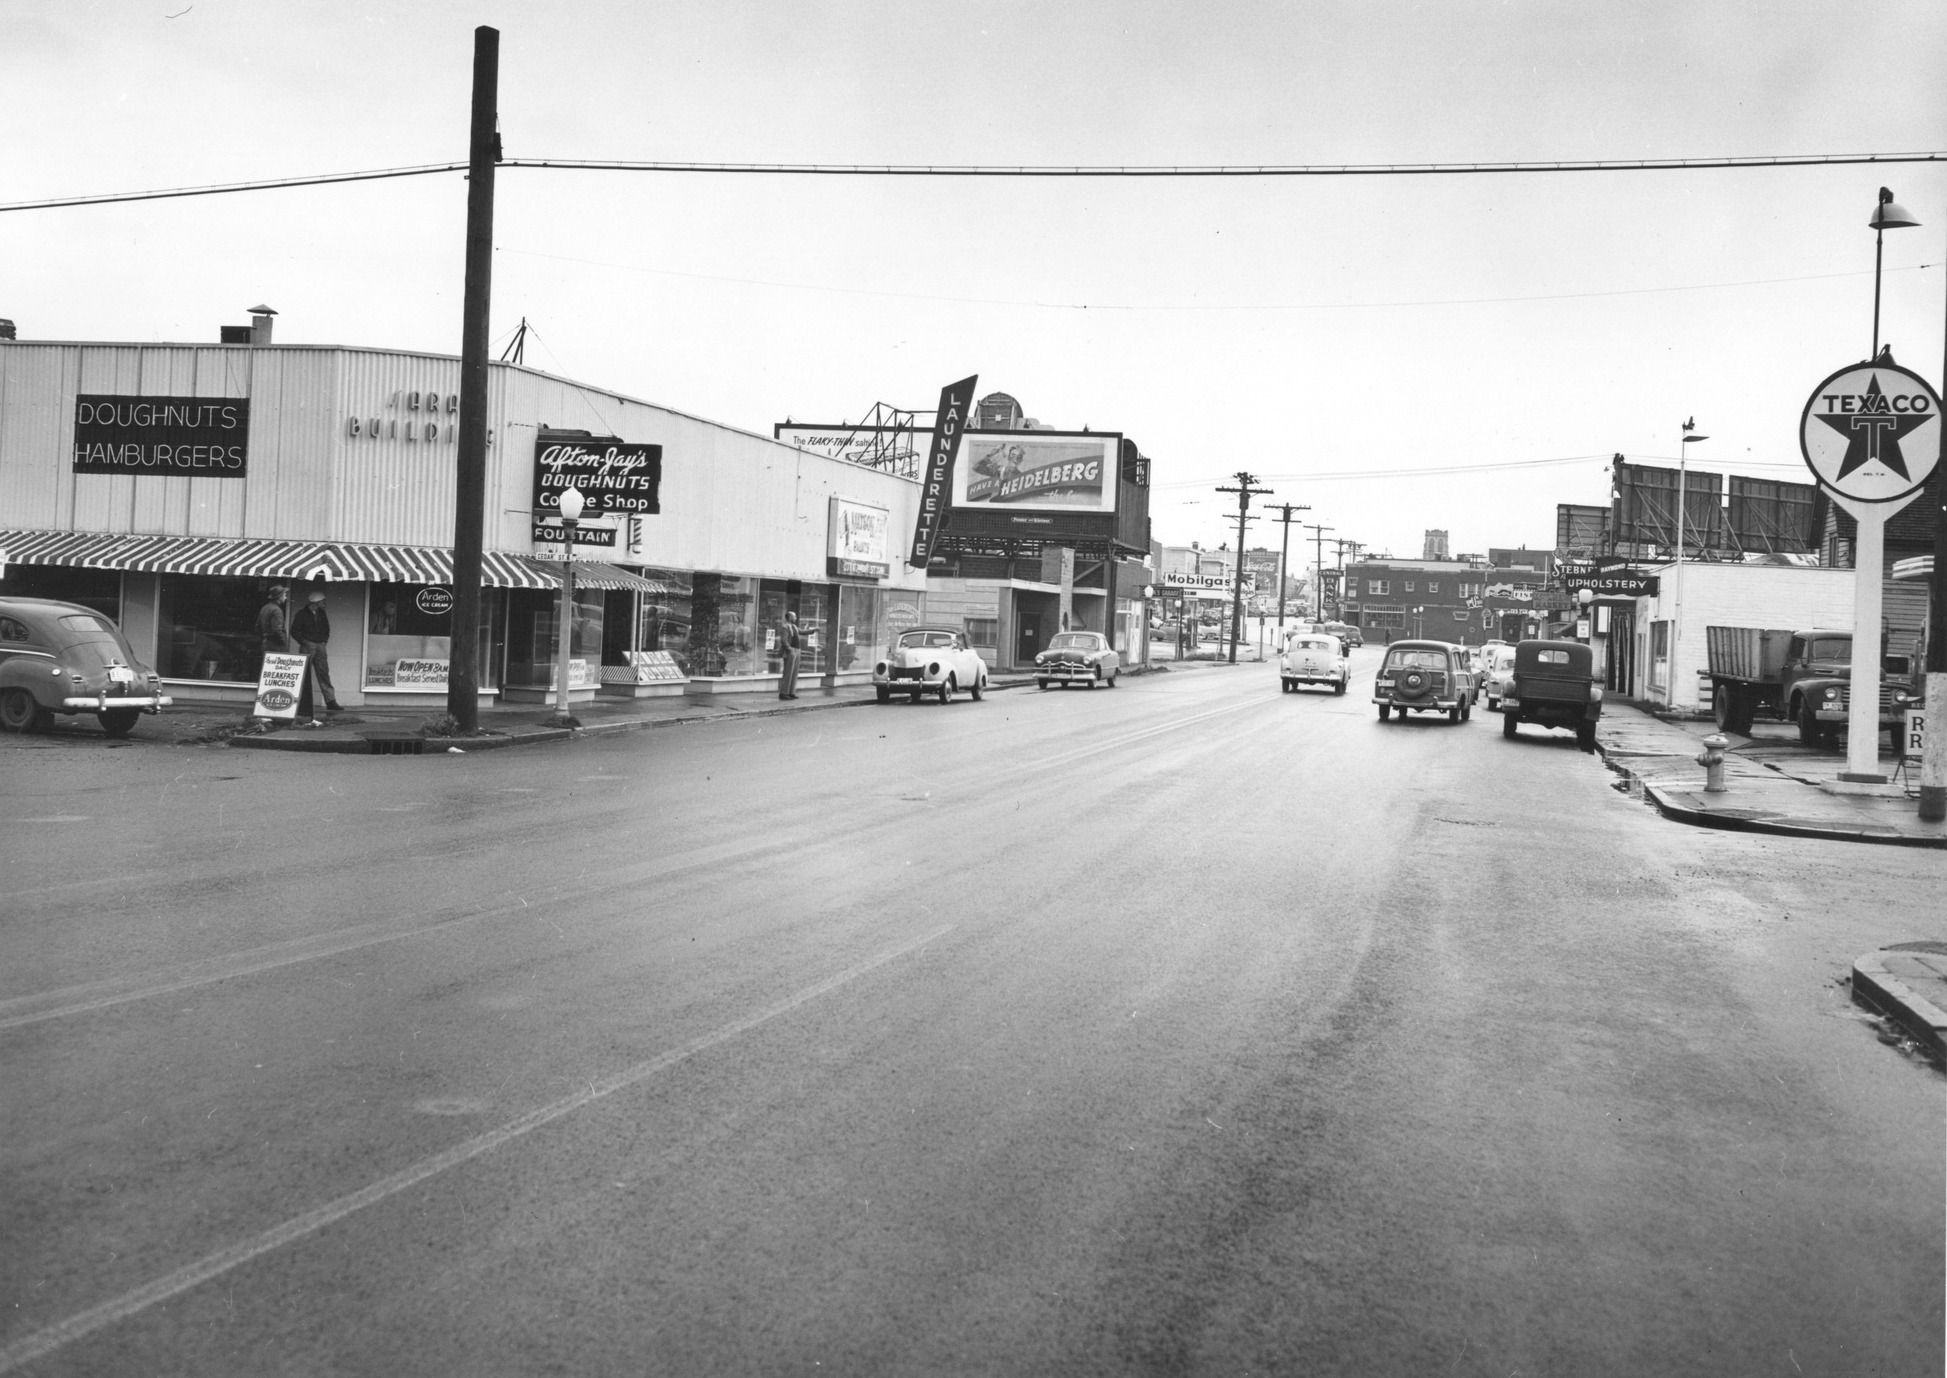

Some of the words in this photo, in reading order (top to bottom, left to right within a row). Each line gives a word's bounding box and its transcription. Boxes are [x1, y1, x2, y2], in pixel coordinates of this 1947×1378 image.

[1822, 394, 1930, 413] TEXACO
[78, 403, 237, 429] DOUGHNUTS
[349, 416, 494, 446] BUILDIG
[793, 435, 806, 445] The
[807, 436, 855, 446] FLAKY-THIN
[74, 443, 242, 468] HAMBURGERS
[540, 445, 649, 475] Afton-Jay's
[541, 473, 651, 490] DOUGHNUTS
[916, 392, 961, 556] LAUNDERETTE
[1000, 461, 1099, 496] HEIDELBERG
[969, 480, 992, 495] HAVE
[994, 479, 1000, 488] A
[540, 492, 597, 508] Coe
[603, 494, 649, 511] Shop
[534, 528, 611, 542] FOUTAIN
[1167, 574, 1230, 586] Mobilgas
[1568, 579, 1648, 589] UPHOLSTERY
[421, 591, 449, 602] Arden
[398, 660, 415, 672] NOW
[414, 661, 434, 672] OPEN
[263, 671, 300, 681] BREAKFAST
[264, 679, 296, 688] LUNCHES
[397, 673, 421, 683] Breakfast
[263, 694, 291, 704] Arden
